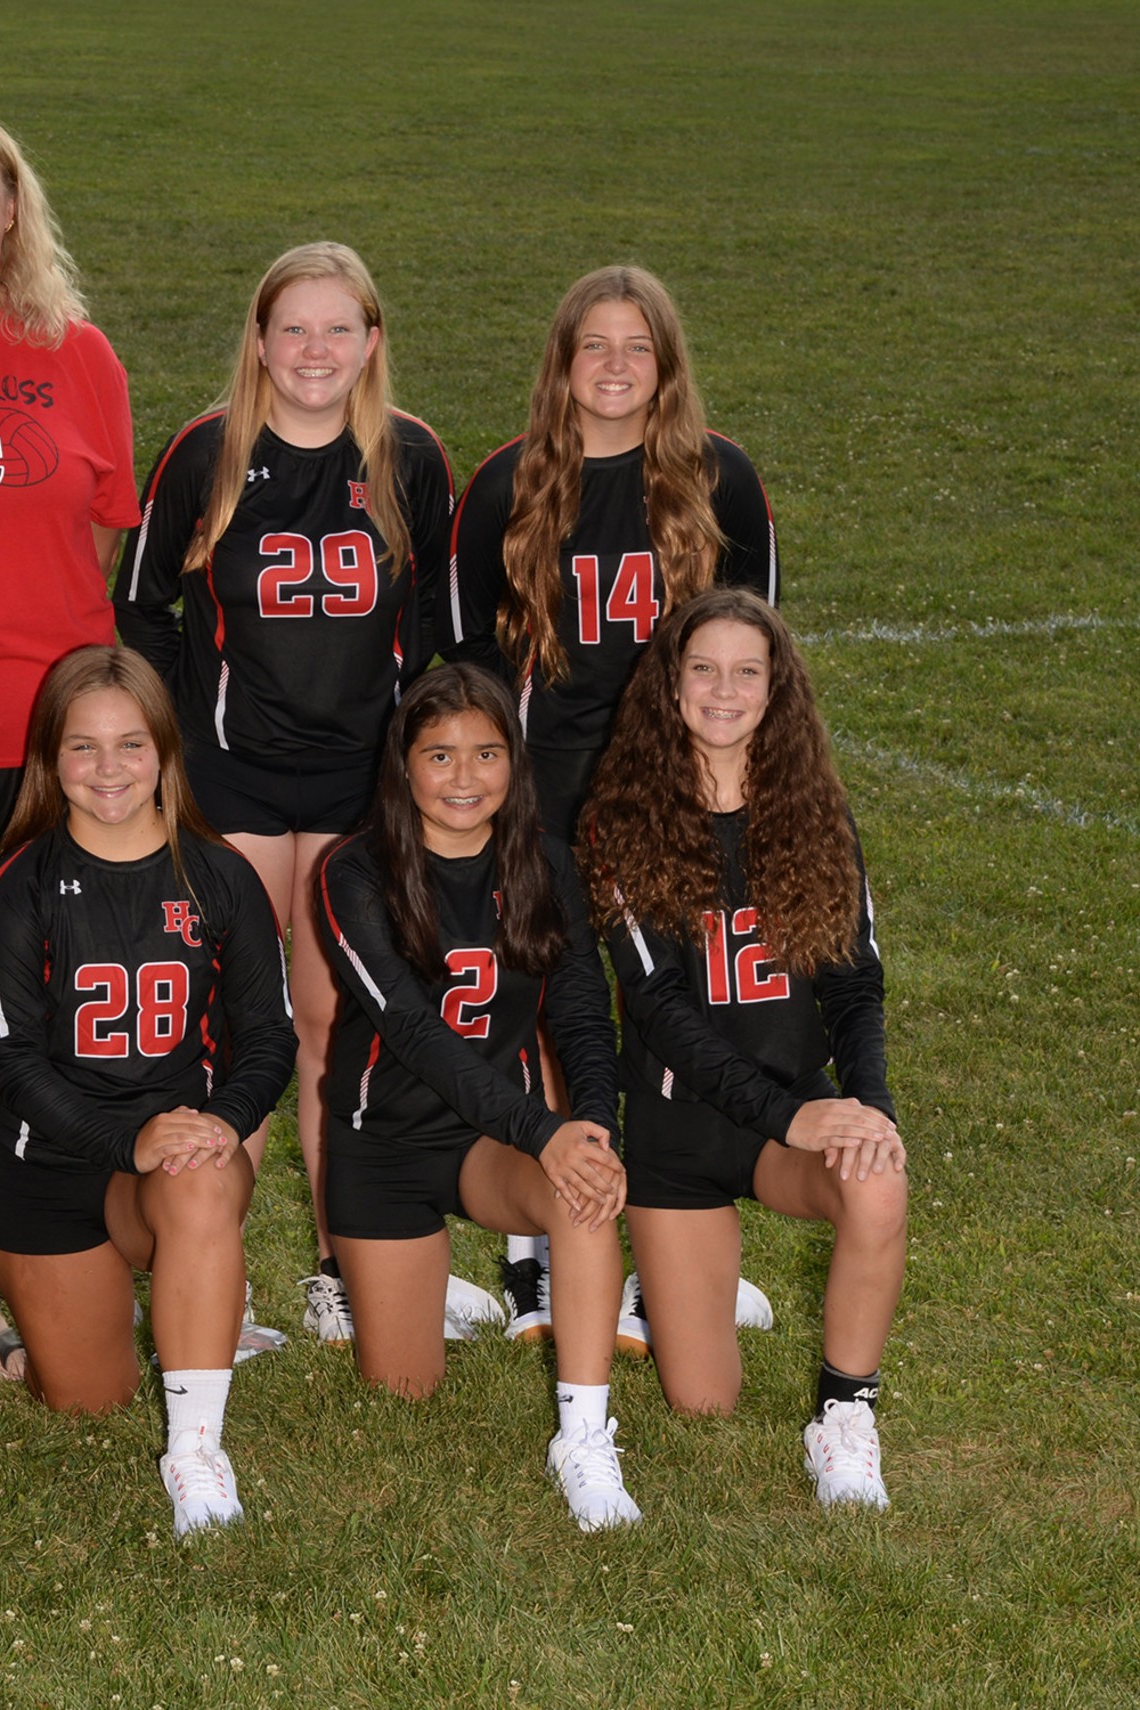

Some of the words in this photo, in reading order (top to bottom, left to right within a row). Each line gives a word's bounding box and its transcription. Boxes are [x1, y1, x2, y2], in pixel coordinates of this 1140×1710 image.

[257, 530, 378, 618] 29
[572, 551, 659, 645] 14
[161, 900, 203, 948] HC
[702, 906, 790, 1005] 12
[74, 961, 190, 1058] 28
[441, 947, 497, 1039] 2
